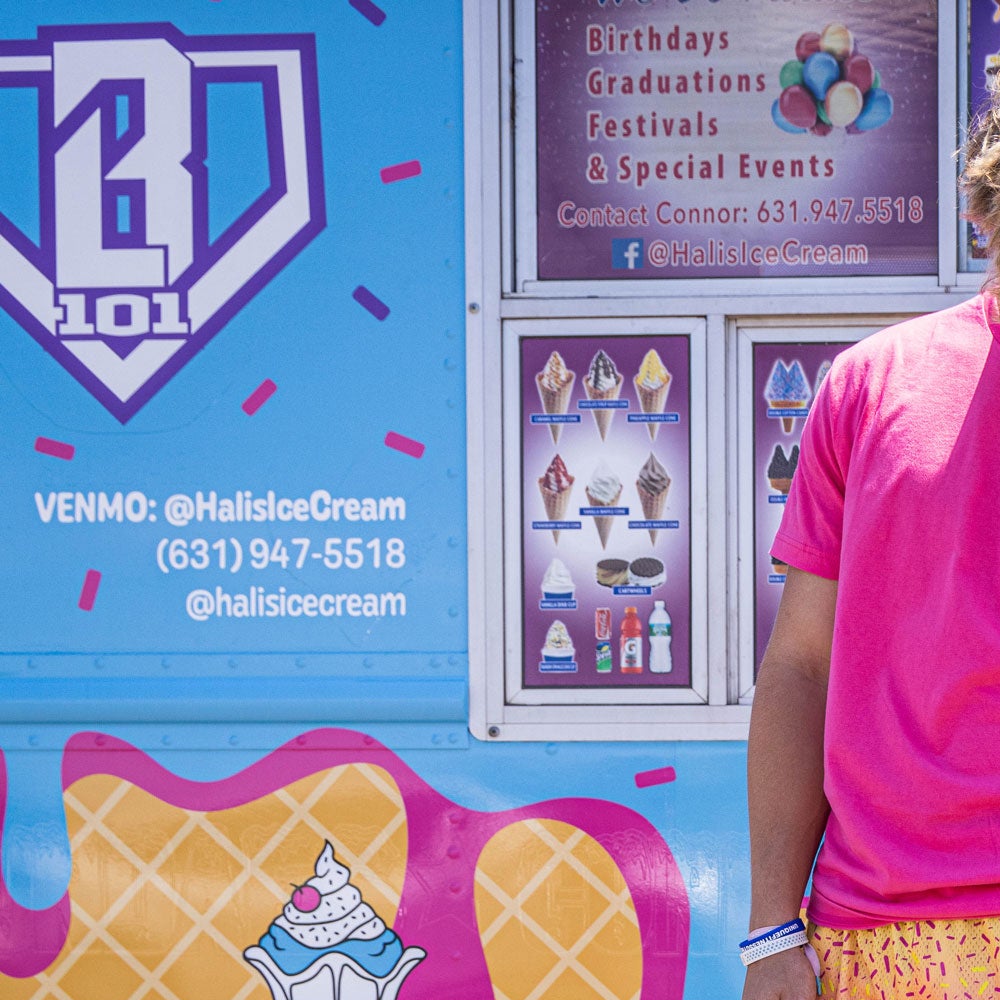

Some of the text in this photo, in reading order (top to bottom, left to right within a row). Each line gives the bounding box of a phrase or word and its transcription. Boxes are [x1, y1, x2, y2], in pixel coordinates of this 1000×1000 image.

[587, 25, 730, 57] Birthdays
[587, 68, 767, 97] Graduations
[587, 111, 720, 140] Festivals
[587, 153, 836, 188] & Special Events
[557, 196, 925, 229] Contact Connor: 631.947.5518
[648, 239, 870, 269] @HalisIceCream
[34, 490, 407, 526] VENMO: @HalisIceCream
[156, 537, 406, 574] (631) 947-5518
[186, 586, 407, 622] @halisicecream
